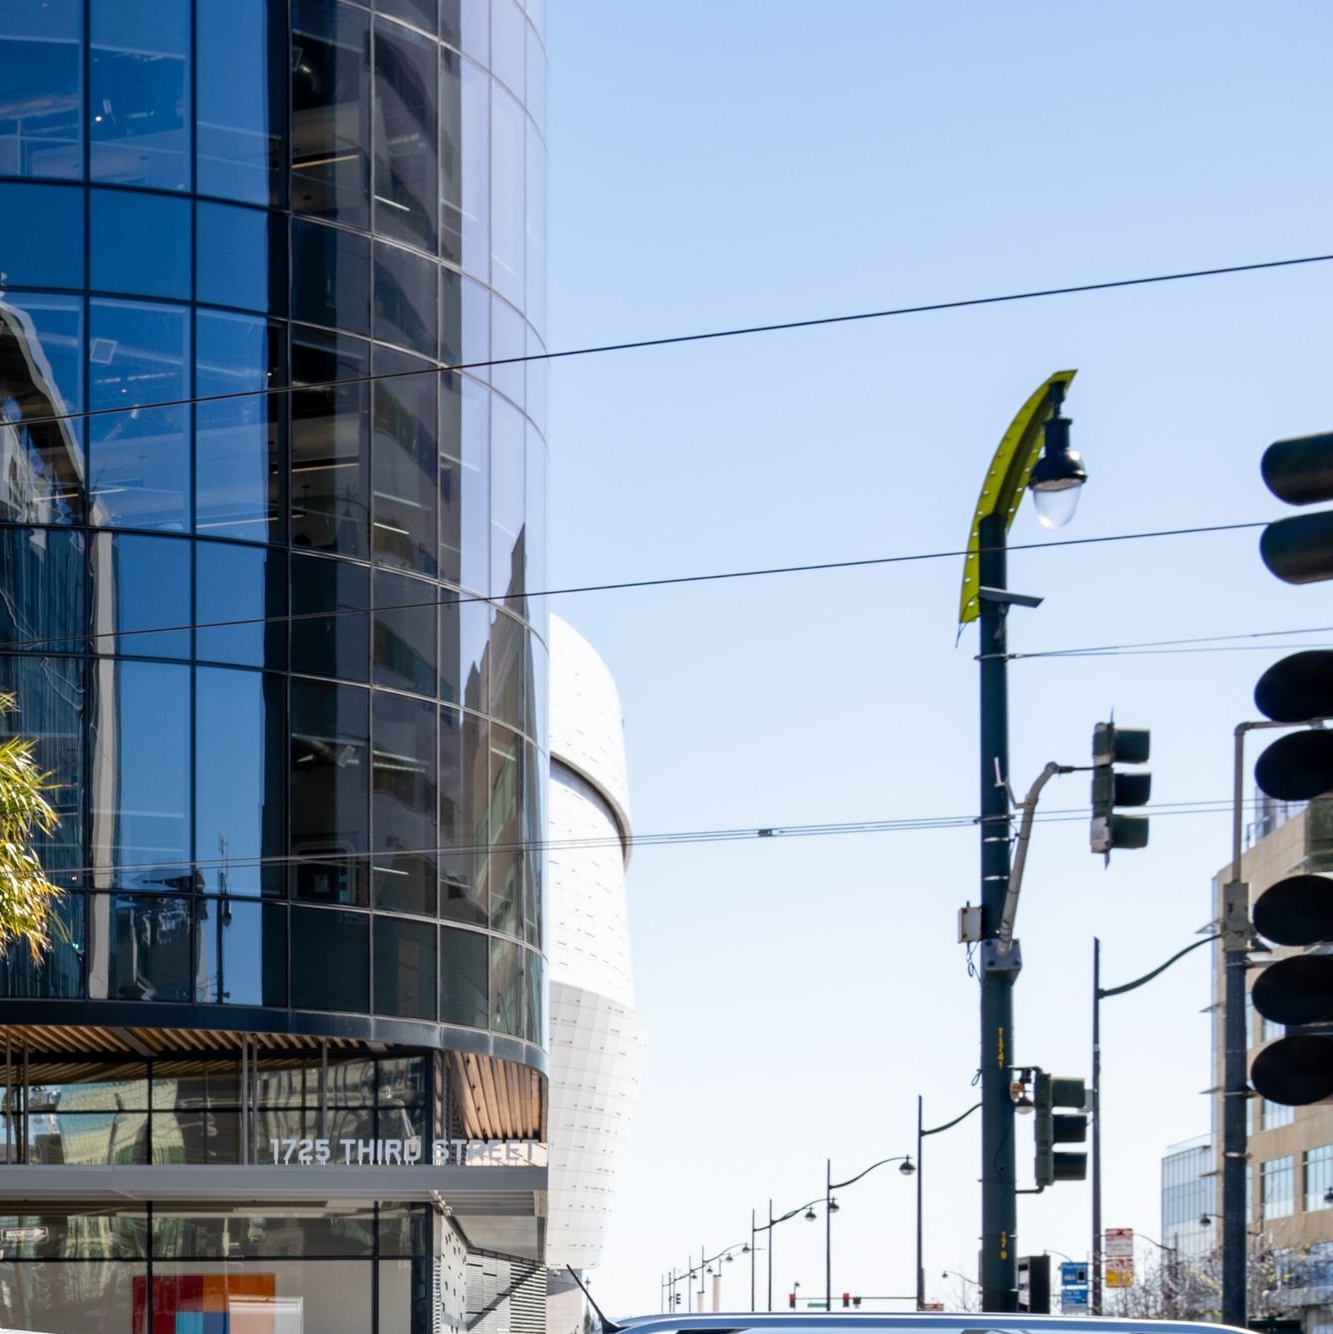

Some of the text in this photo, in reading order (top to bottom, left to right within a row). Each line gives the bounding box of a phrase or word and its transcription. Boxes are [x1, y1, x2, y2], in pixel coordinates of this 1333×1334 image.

[269, 1138, 539, 1162] 1725 THIRD STREET
